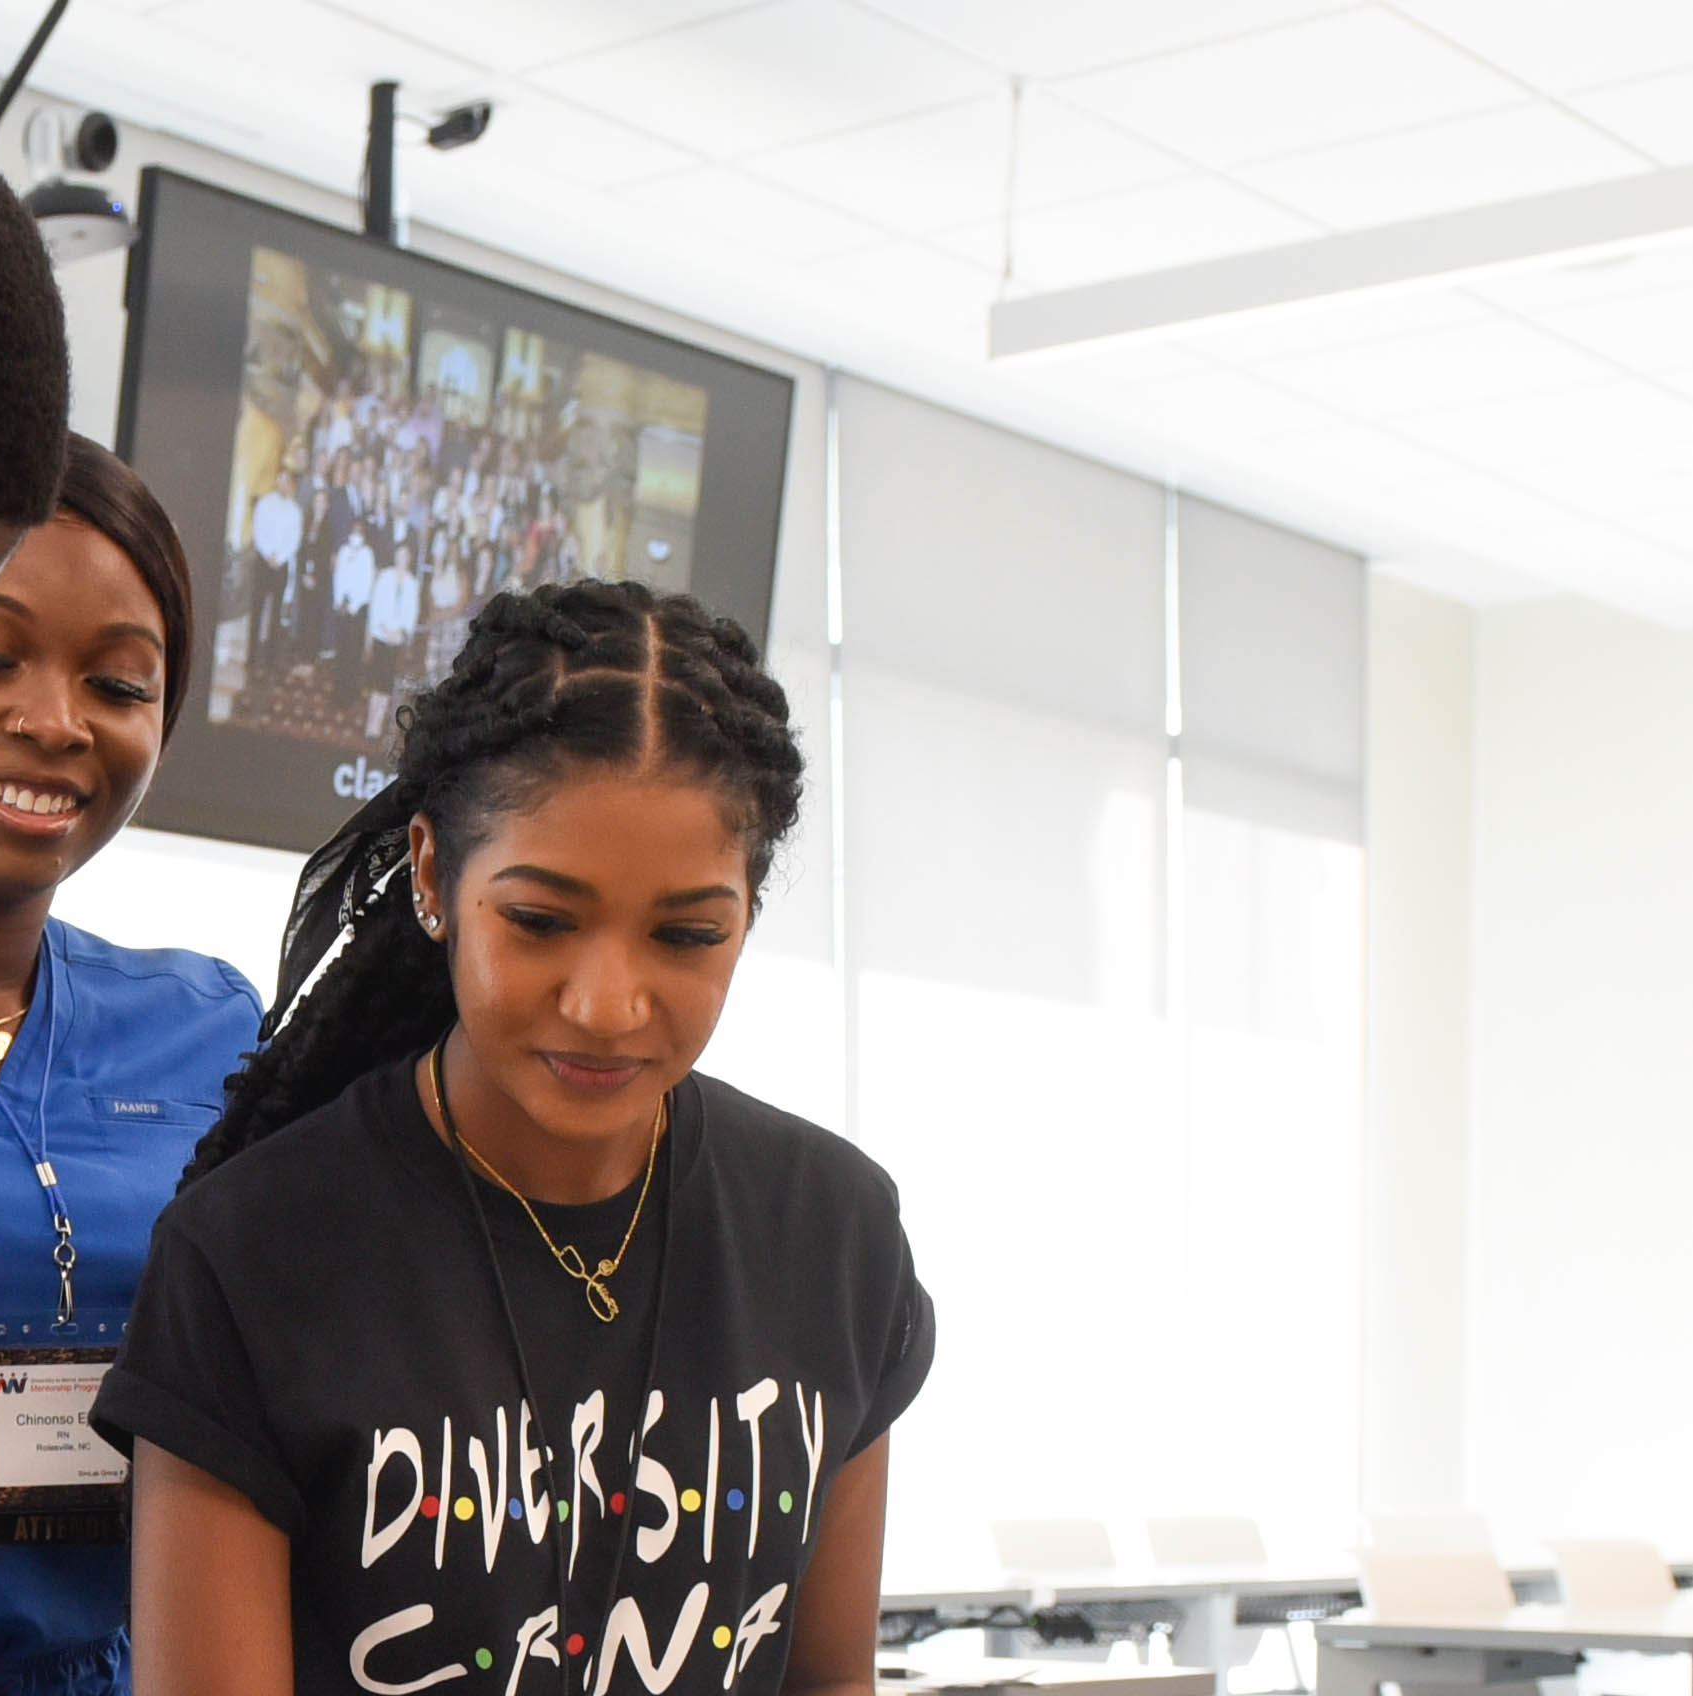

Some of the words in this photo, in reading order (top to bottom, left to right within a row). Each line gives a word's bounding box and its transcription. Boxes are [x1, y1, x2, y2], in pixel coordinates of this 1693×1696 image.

[333, 755, 399, 800] cla
[16, 1413, 75, 1426] Chinonso
[56, 1431, 70, 1439] RN
